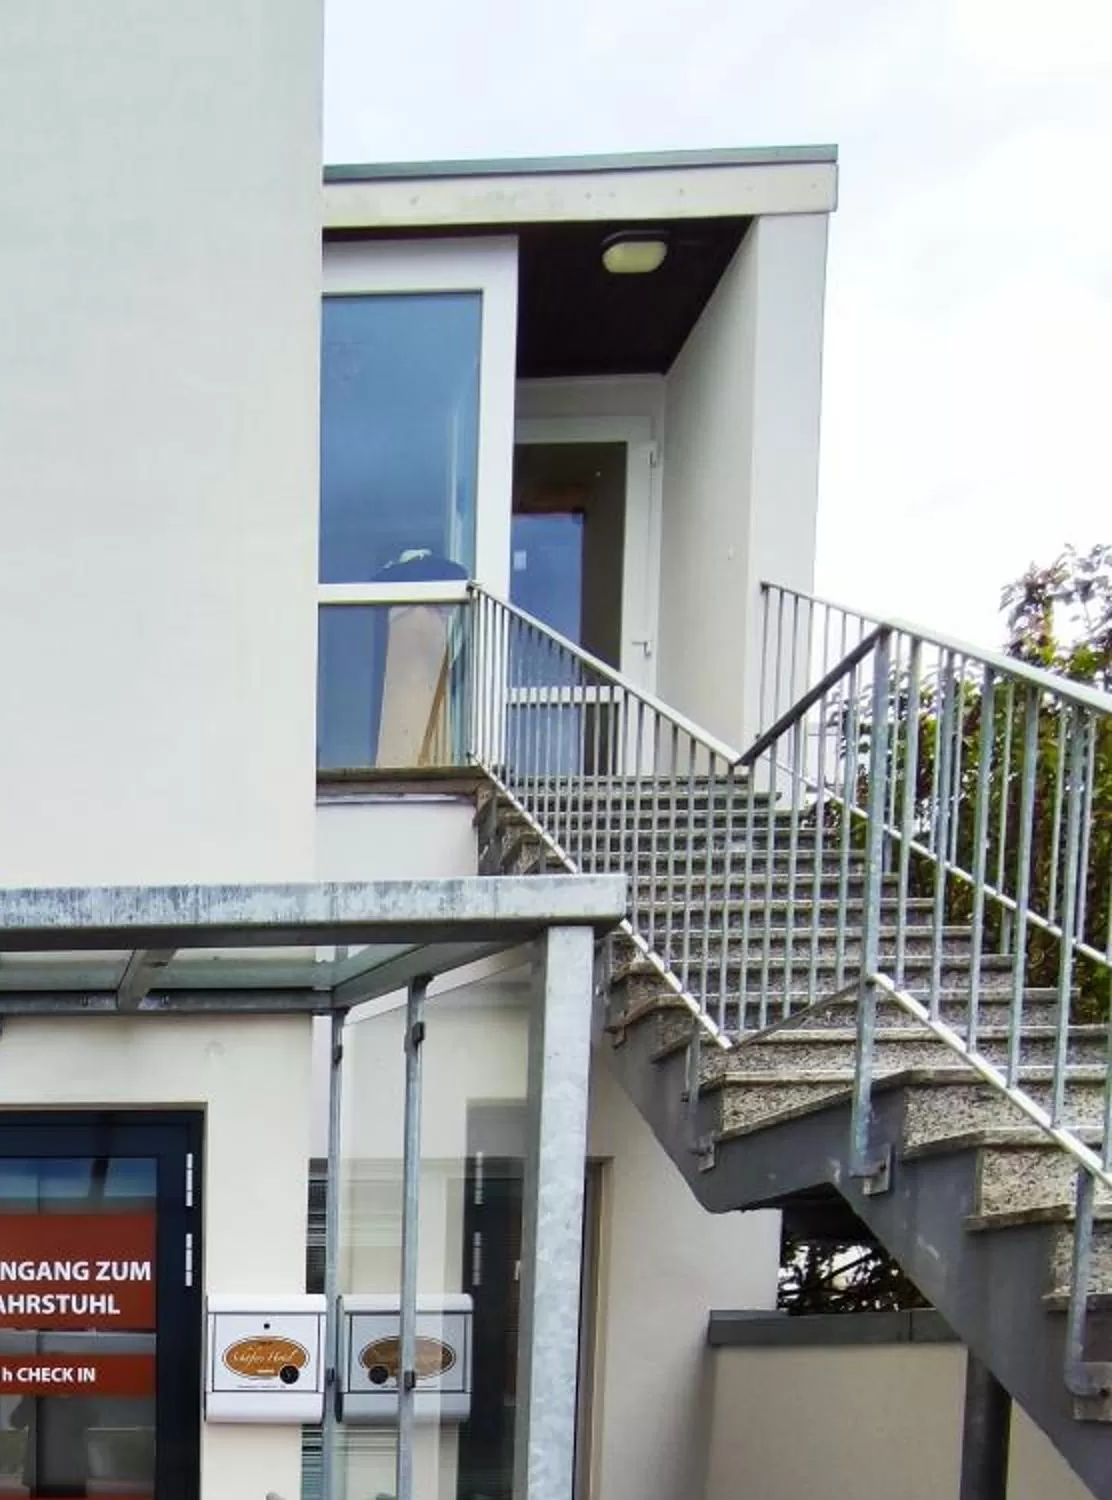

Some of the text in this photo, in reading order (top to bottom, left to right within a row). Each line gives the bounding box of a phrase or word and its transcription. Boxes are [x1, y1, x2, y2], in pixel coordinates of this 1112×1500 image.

[94, 1261, 152, 1281] ZUM
[1, 1367, 14, 1383] h
[16, 1367, 75, 1383] CHECK
[77, 1367, 96, 1383] IN
